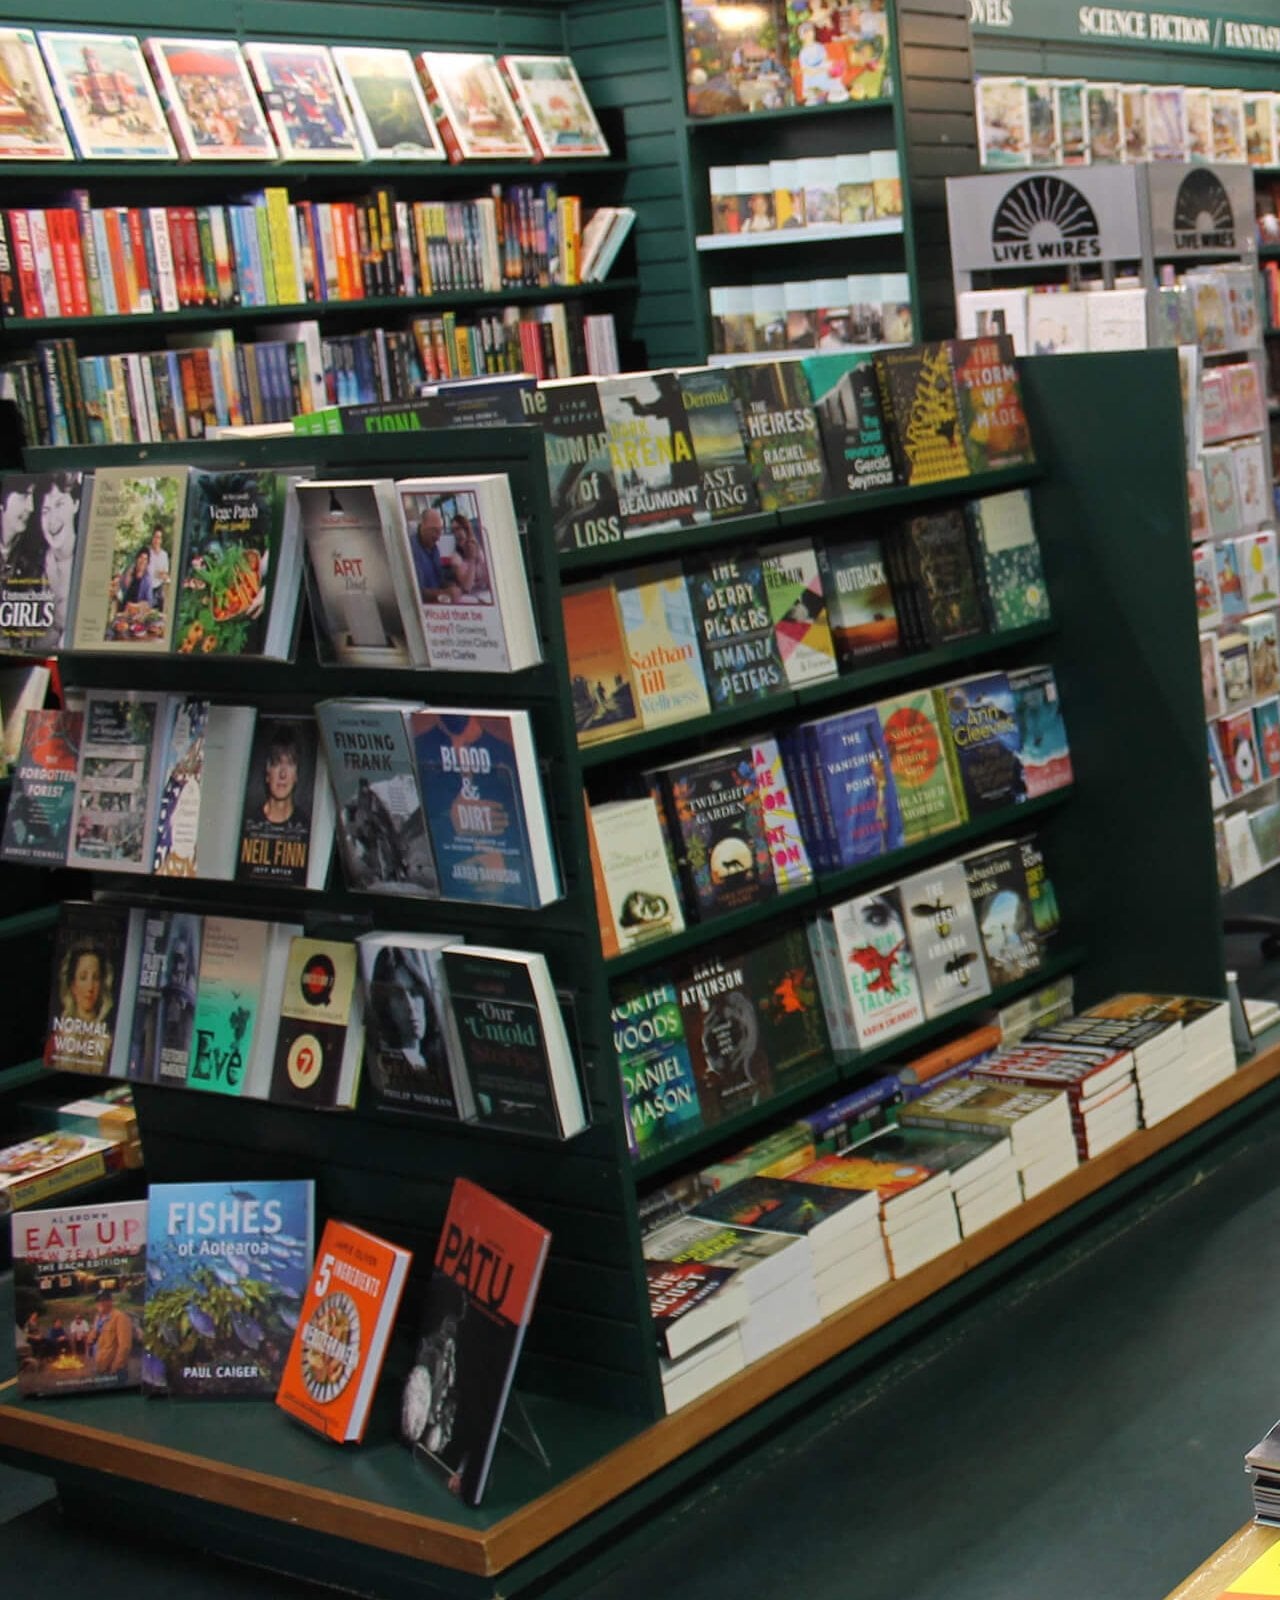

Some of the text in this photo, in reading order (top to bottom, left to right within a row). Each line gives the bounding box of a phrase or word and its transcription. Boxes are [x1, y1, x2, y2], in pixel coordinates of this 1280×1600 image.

[1078, 6, 1146, 38] SCIENCE
[1149, 14, 1210, 44] FICTION
[992, 239, 1100, 262] LIVE WIRES
[1174, 229, 1236, 249] LIVE WIRES
[974, 343, 999, 364] THE
[963, 366, 1019, 388] STORM
[751, 400, 768, 413] THE
[975, 407, 1020, 430] MADE
[747, 408, 816, 439] HEIRESS
[608, 431, 692, 469] ARENA
[763, 444, 807, 466] RACHEL
[771, 459, 822, 481] HAWKINS
[580, 472, 600, 501] of
[619, 485, 699, 516] BEAUMONT
[573, 516, 622, 548] LOSS
[333, 558, 363, 578] ART
[712, 562, 740, 582] THE
[835, 561, 887, 594] OUTBACK
[706, 583, 754, 612] BERRY
[0, 601, 55, 628] GIRLS
[425, 609, 483, 622] Would that be
[704, 606, 769, 641] PICKERS
[720, 664, 781, 697] PETERS
[967, 704, 999, 725] Ann
[333, 731, 395, 751] FINDING
[842, 732, 862, 747] THE
[953, 717, 1015, 746] Cleeves
[343, 752, 393, 772] FRANK
[440, 745, 491, 775] BLOOD
[19, 766, 77, 783] FORGOTTEN
[27, 784, 65, 798] FOREST
[460, 776, 480, 800] &
[688, 786, 748, 813] TWILIGHT
[457, 803, 494, 832] DIRT
[695, 801, 747, 825] GARDEN
[241, 837, 307, 869] NEIL FINN
[680, 969, 744, 1012] ATKINSON
[476, 1001, 515, 1023] Our
[53, 1016, 111, 1039] NORMAL
[463, 1016, 537, 1048] Untold
[53, 1034, 105, 1057] WOMEN
[192, 1029, 243, 1086] Eve
[622, 1056, 685, 1099] DANIEL
[629, 1084, 692, 1128] MASON
[166, 1199, 284, 1237] FISHES
[25, 1219, 142, 1252] EAT UP
[178, 1240, 270, 1257] of Aotearoa
[37, 1263, 56, 1274] THE
[86, 1257, 130, 1269] EDITION
[314, 1253, 382, 1299] 5 INGREDIENTS
[440, 1223, 515, 1311] PATU
[183, 1365, 259, 1379] PAUL CAIGER
